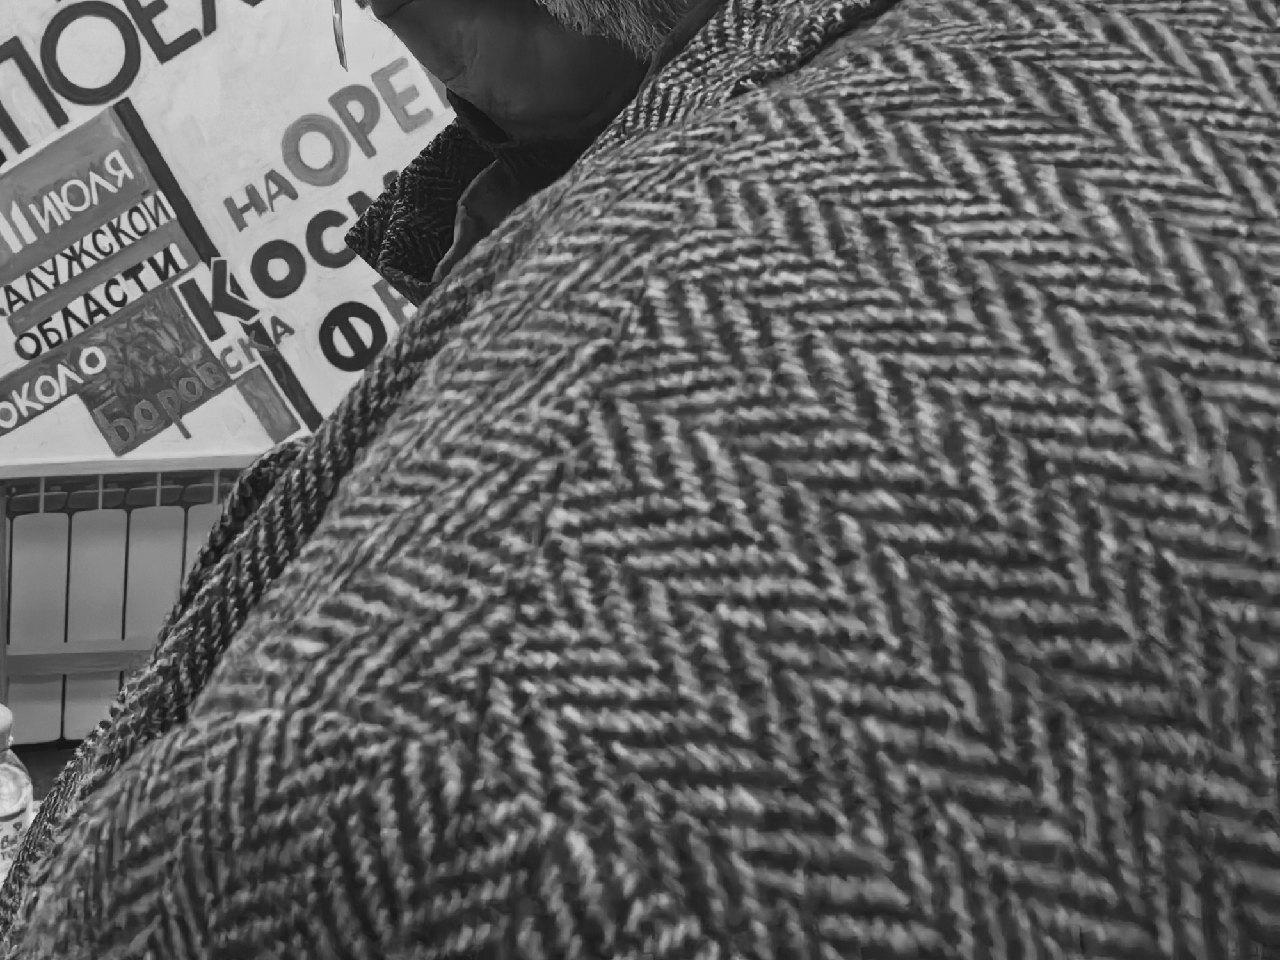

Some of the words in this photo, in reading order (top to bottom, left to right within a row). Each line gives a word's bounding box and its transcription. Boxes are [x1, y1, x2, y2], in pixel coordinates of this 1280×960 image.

[281, 57, 449, 187] ОРЕ
[28, 149, 135, 234] ИЮЛЯ
[14, 242, 189, 360] ОБЛАСТИ
[174, 170, 400, 342] КОС
